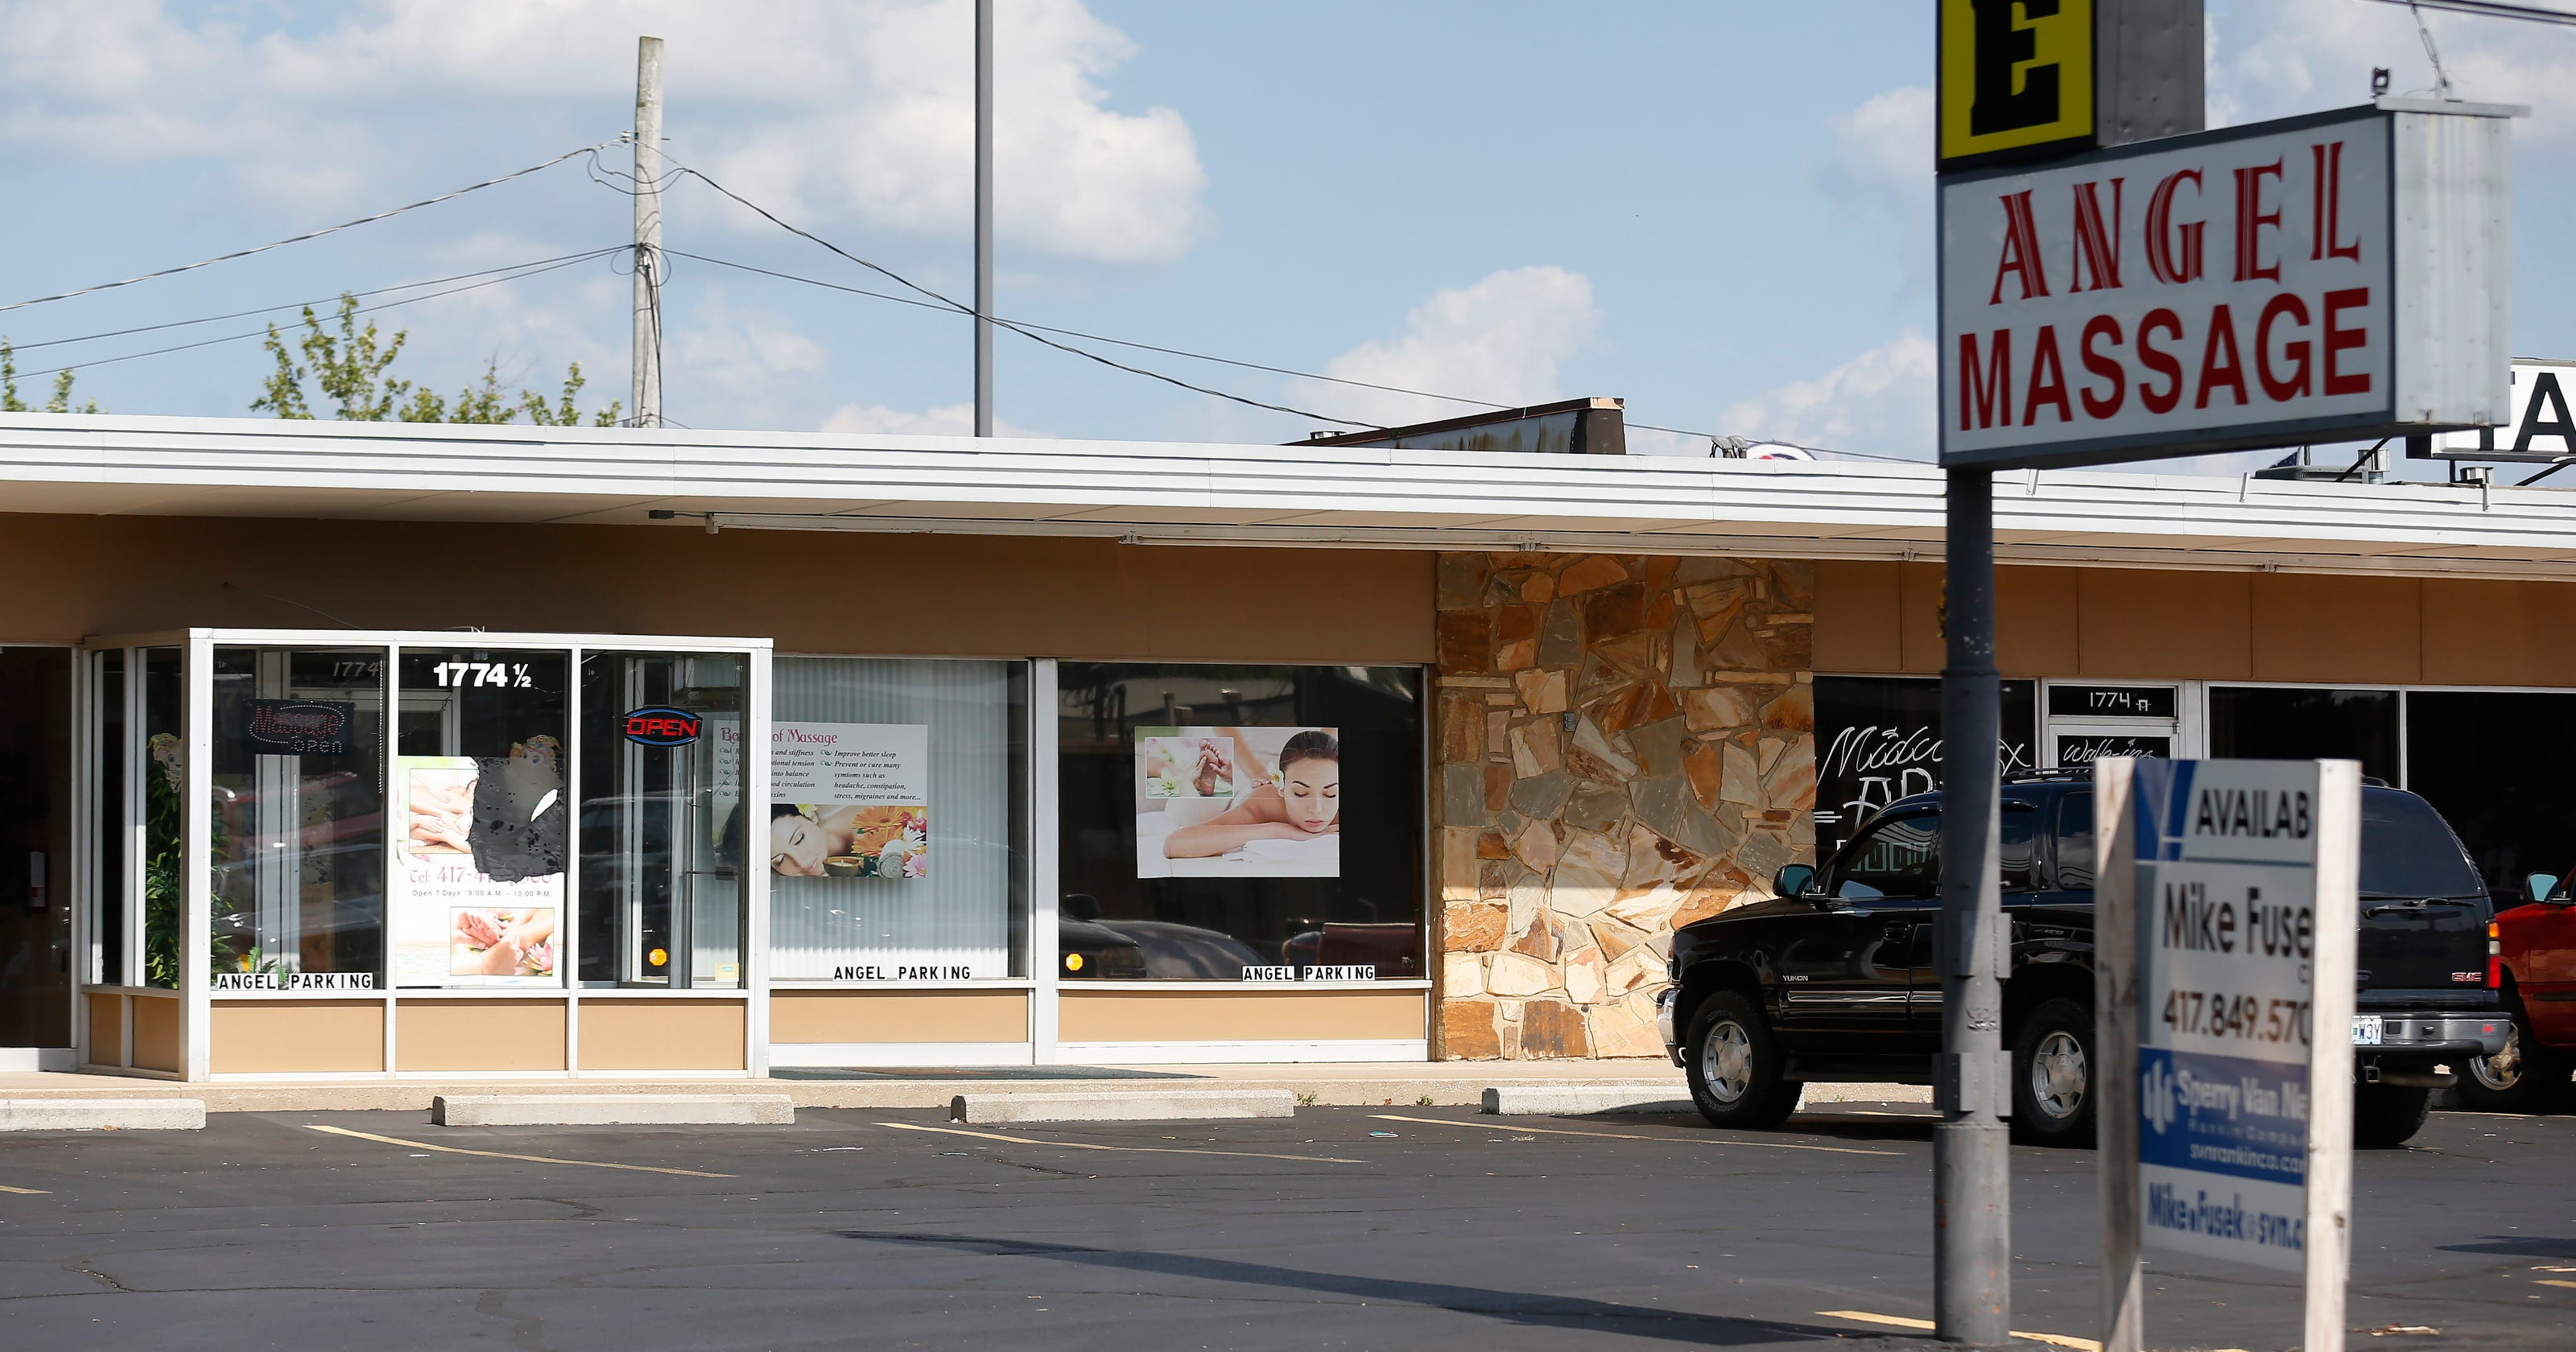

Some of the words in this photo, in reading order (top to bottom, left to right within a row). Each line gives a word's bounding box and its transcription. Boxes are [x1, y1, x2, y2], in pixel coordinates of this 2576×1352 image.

[1971, 0, 2059, 137] E
[1989, 141, 2361, 306] ANGEL
[1959, 287, 2371, 431] MASSAGE
[433, 662, 508, 687] 1774
[2090, 692, 2130, 708] 1774
[627, 718, 698, 736] OPEN
[773, 728, 784, 742] of
[787, 728, 838, 747] Massage
[789, 748, 814, 757] stiffness
[835, 751, 860, 759] Improve
[867, 783, 906, 791] constipation,
[2195, 789, 2310, 839] AVAILAB
[412, 889, 433, 897] Open
[442, 889, 460, 897] Days
[2163, 881, 2236, 954] Mike
[2247, 887, 2311, 958] Fuse
[834, 966, 886, 979] ANGEL
[898, 966, 971, 979] PARKING
[1244, 967, 1293, 980] ANGEL
[1305, 967, 1373, 979] PARKING
[2451, 972, 2483, 982] GMC
[218, 975, 276, 989] ANGEL
[291, 974, 371, 989] PARKING
[2178, 1070, 2240, 1120] Sperry
[2241, 1076, 2278, 1116] Van
